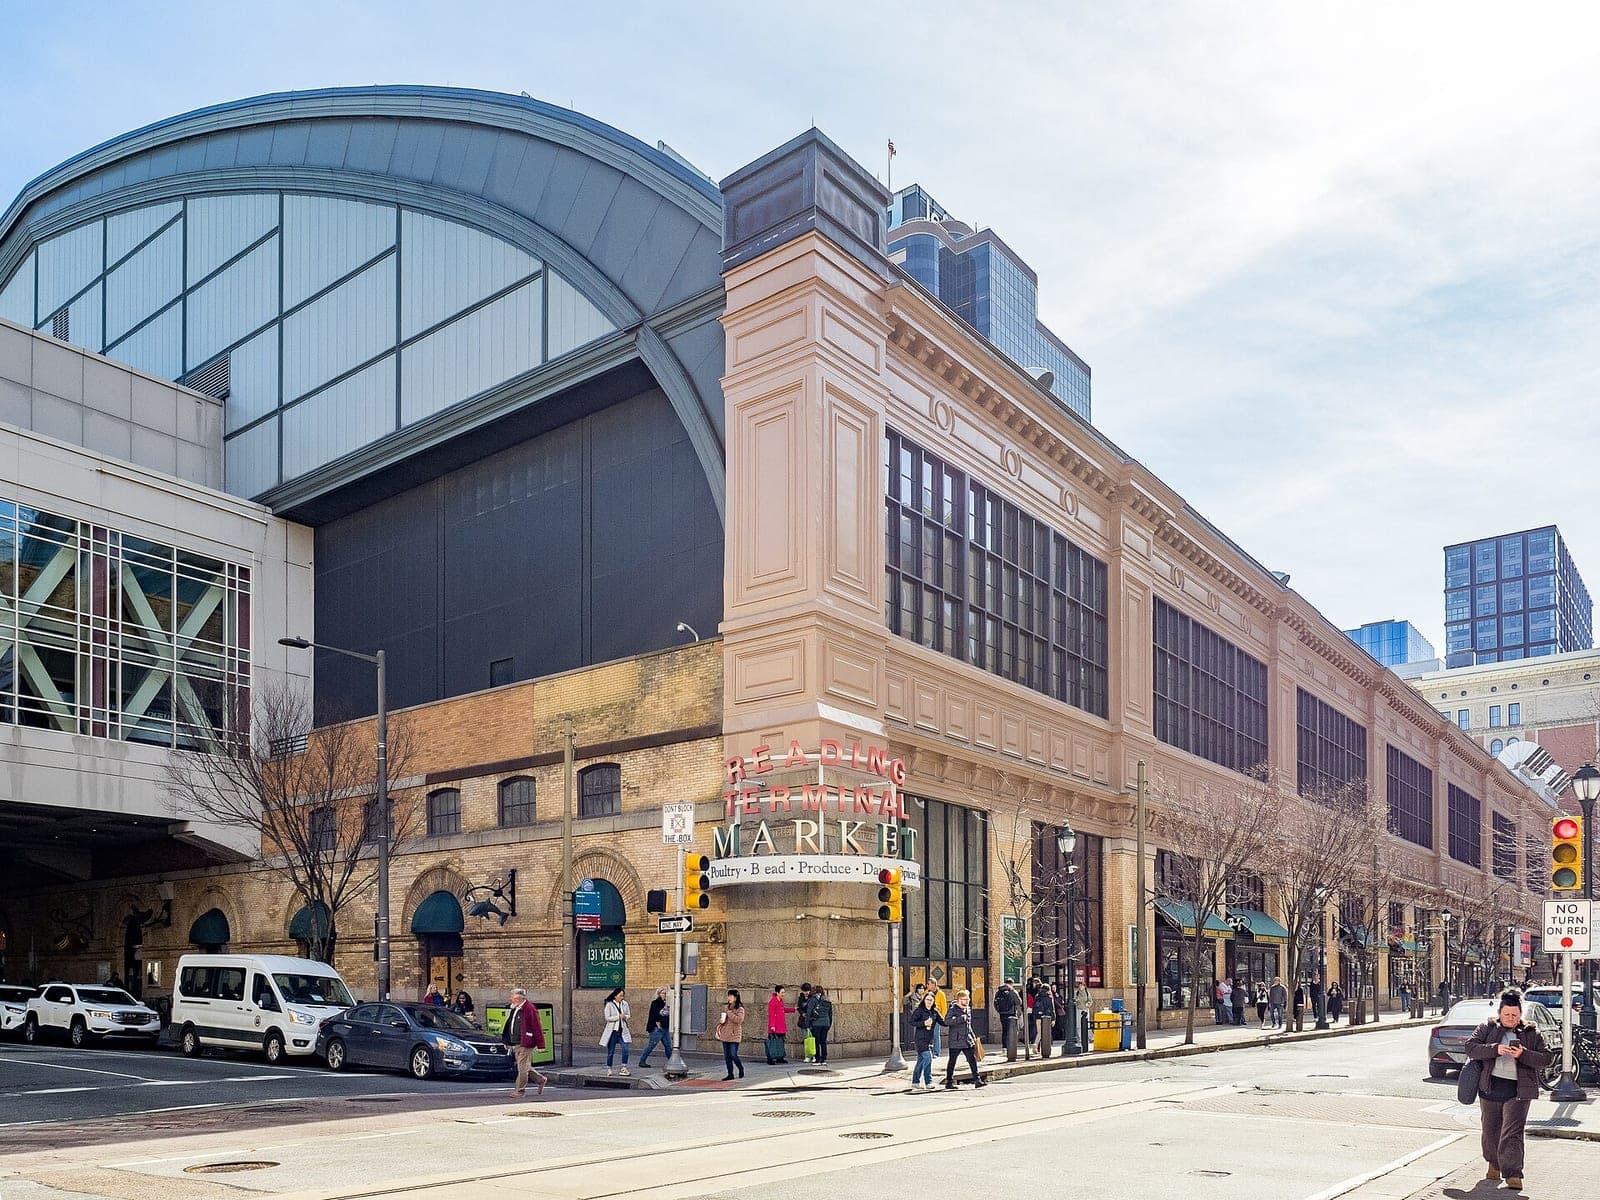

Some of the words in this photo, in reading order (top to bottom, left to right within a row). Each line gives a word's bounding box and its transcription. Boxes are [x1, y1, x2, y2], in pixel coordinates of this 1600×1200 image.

[725, 739, 906, 786] READING
[723, 784, 910, 819] TERMINAL
[665, 834, 676, 843] THE
[678, 833, 692, 843] BOX
[711, 820, 918, 860] MARKET
[711, 864, 741, 879] Poultry
[798, 861, 851, 875] Produce
[1556, 904, 1578, 914] NO
[661, 921, 671, 930] ONE
[672, 920, 682, 929] WAY
[1551, 916, 1584, 925] TURN
[1546, 927, 1563, 936] ON
[1567, 926, 1588, 935] RED
[588, 948, 598, 961] 131
[600, 948, 624, 961] YEARS
